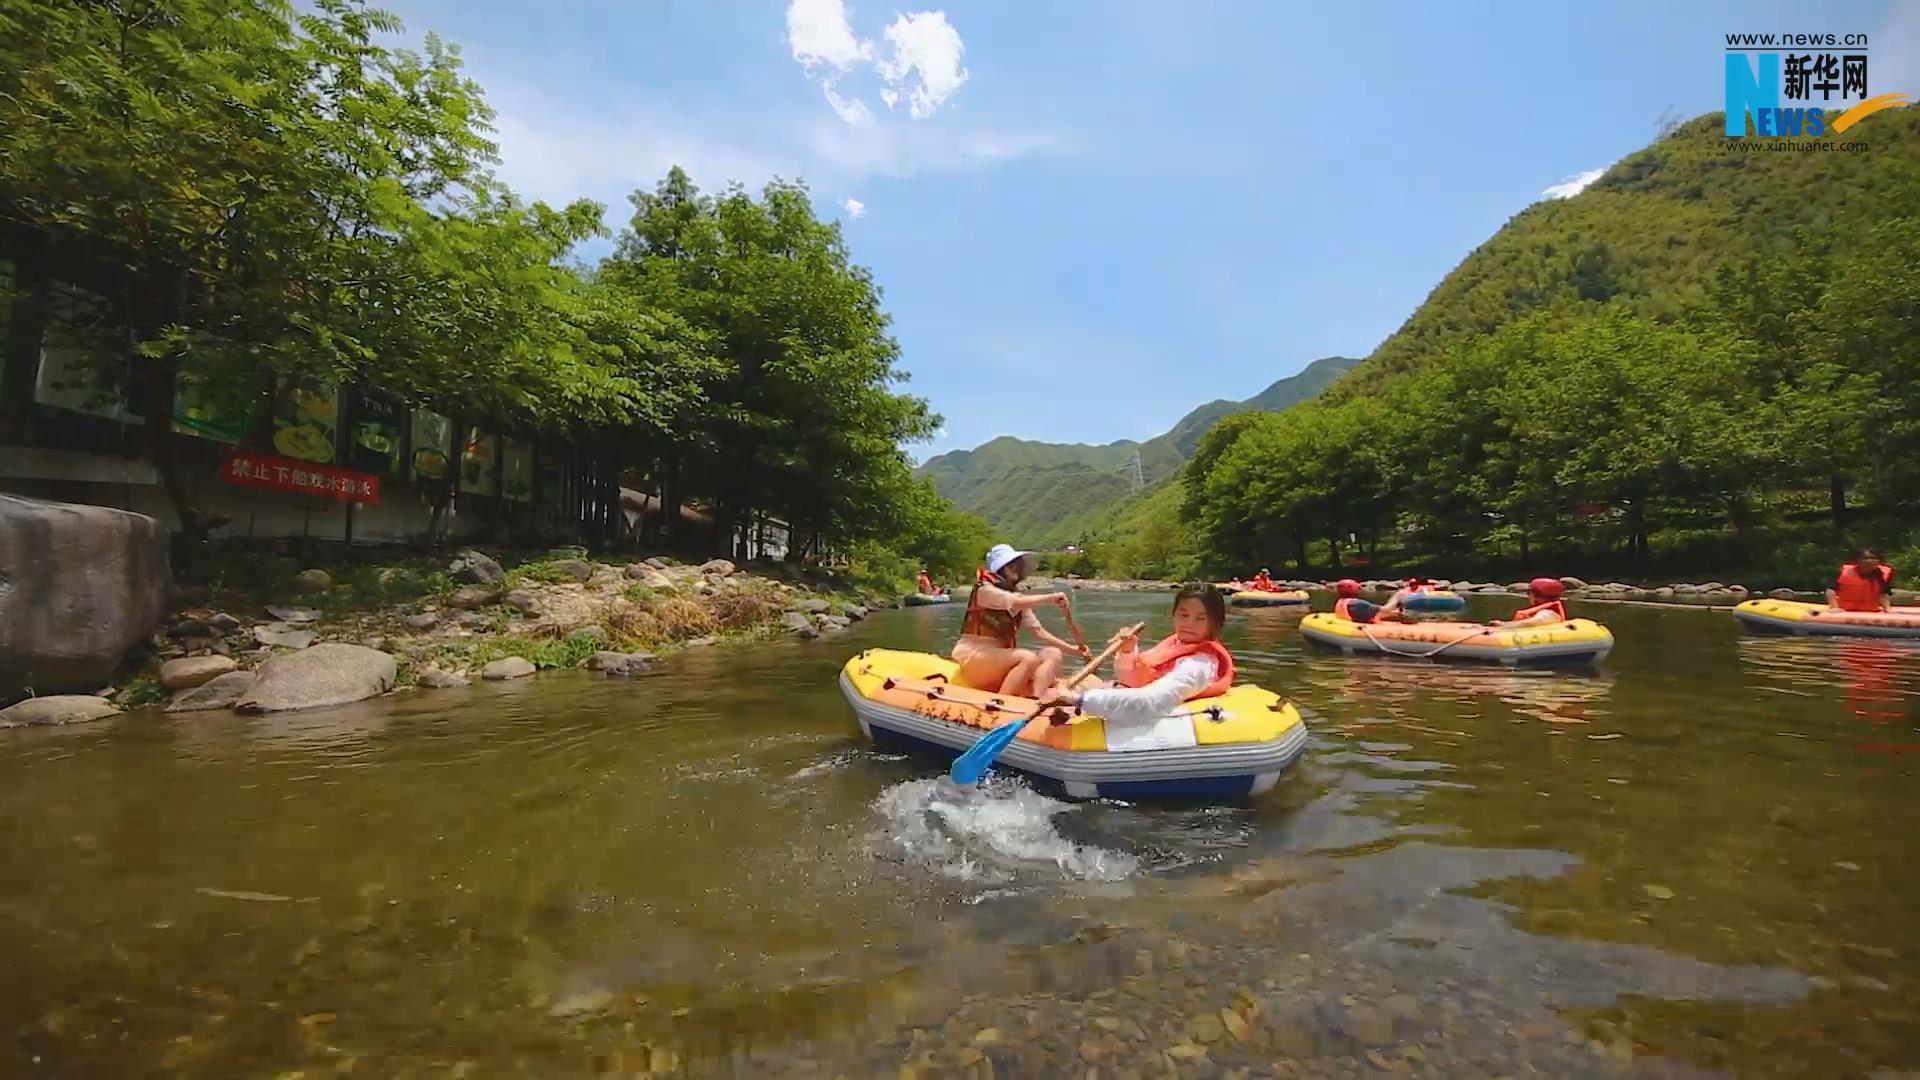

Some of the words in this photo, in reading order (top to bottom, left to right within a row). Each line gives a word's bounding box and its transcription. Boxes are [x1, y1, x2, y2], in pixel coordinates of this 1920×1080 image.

[232, 458, 371, 496] 禁止下船戏水游泳
